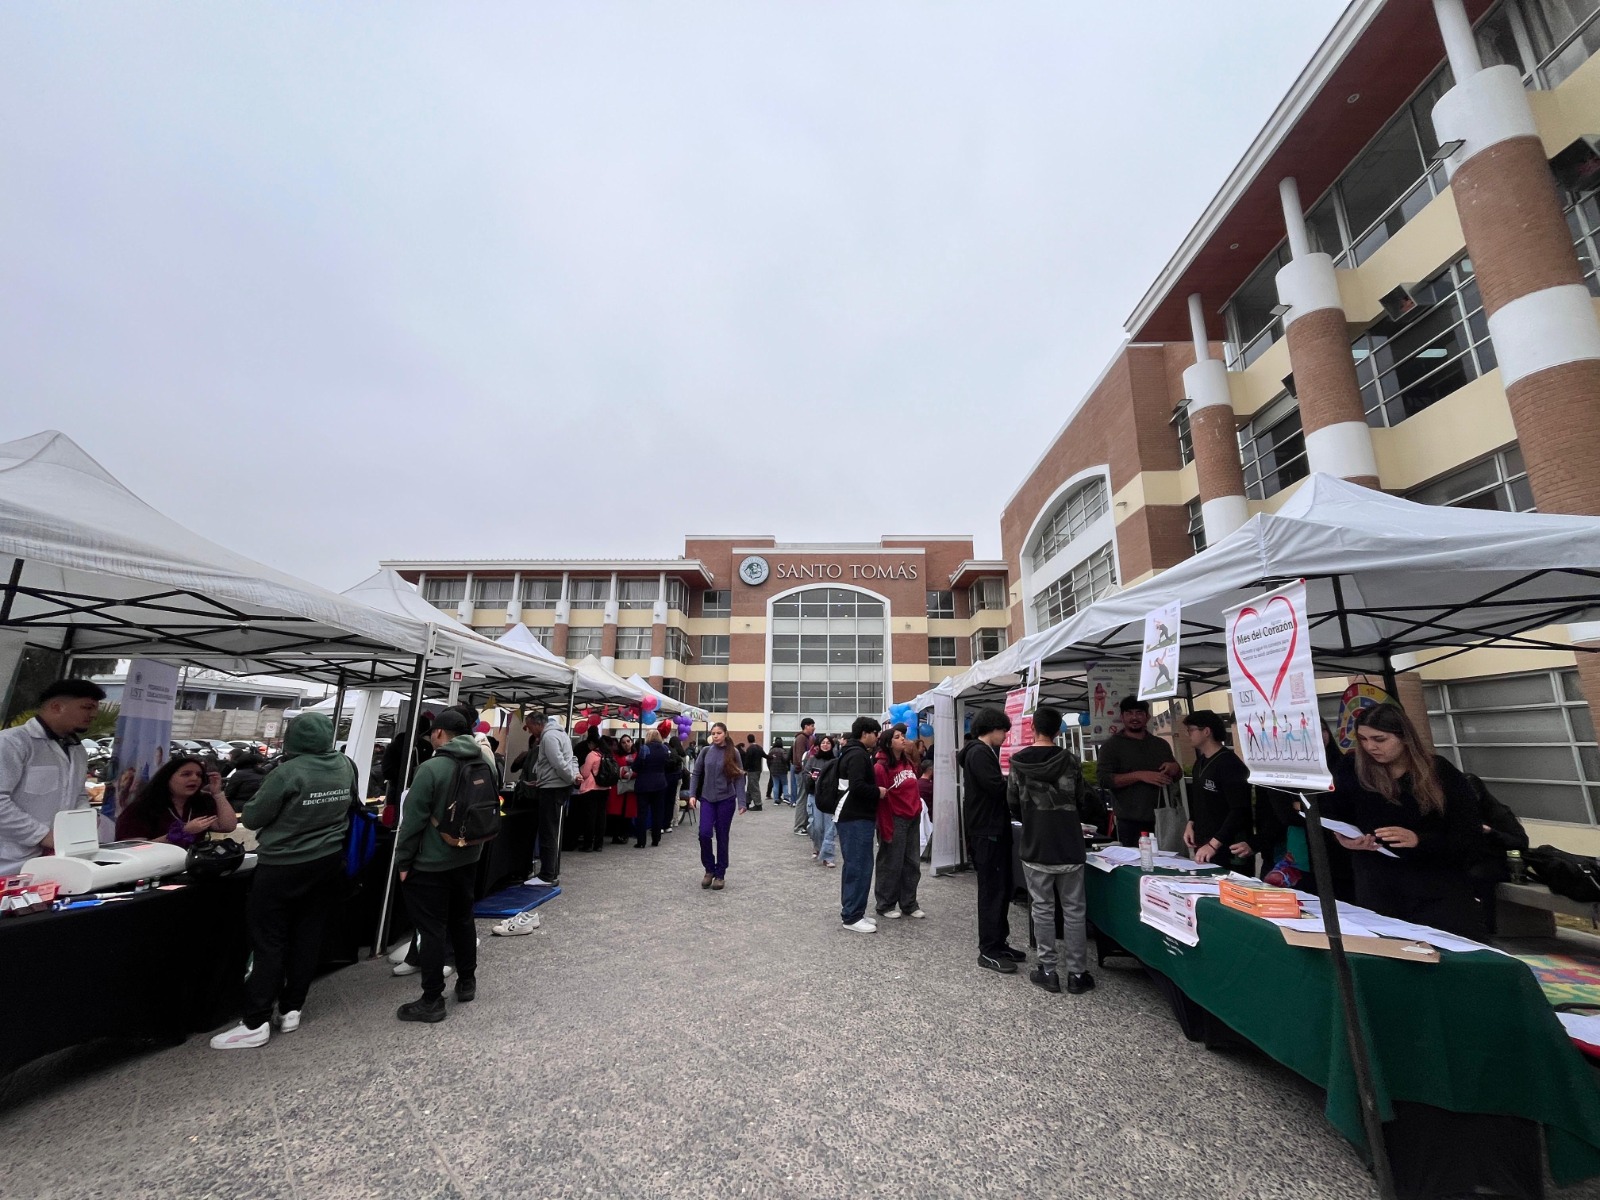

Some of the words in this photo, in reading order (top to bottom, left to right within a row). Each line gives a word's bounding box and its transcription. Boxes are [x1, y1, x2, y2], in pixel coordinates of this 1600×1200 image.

[777, 563, 842, 579] SANTO
[849, 560, 918, 580] TOMÁS
[1236, 634, 1251, 645] Mes
[1251, 628, 1262, 641] del
[1262, 620, 1294, 637] Corazón
[1239, 690, 1255, 704] UST
[1366, 688, 1376, 696] 10
[310, 789, 344, 798] PEDAGOGÍA
[302, 796, 339, 806] EDUCACIÓN
